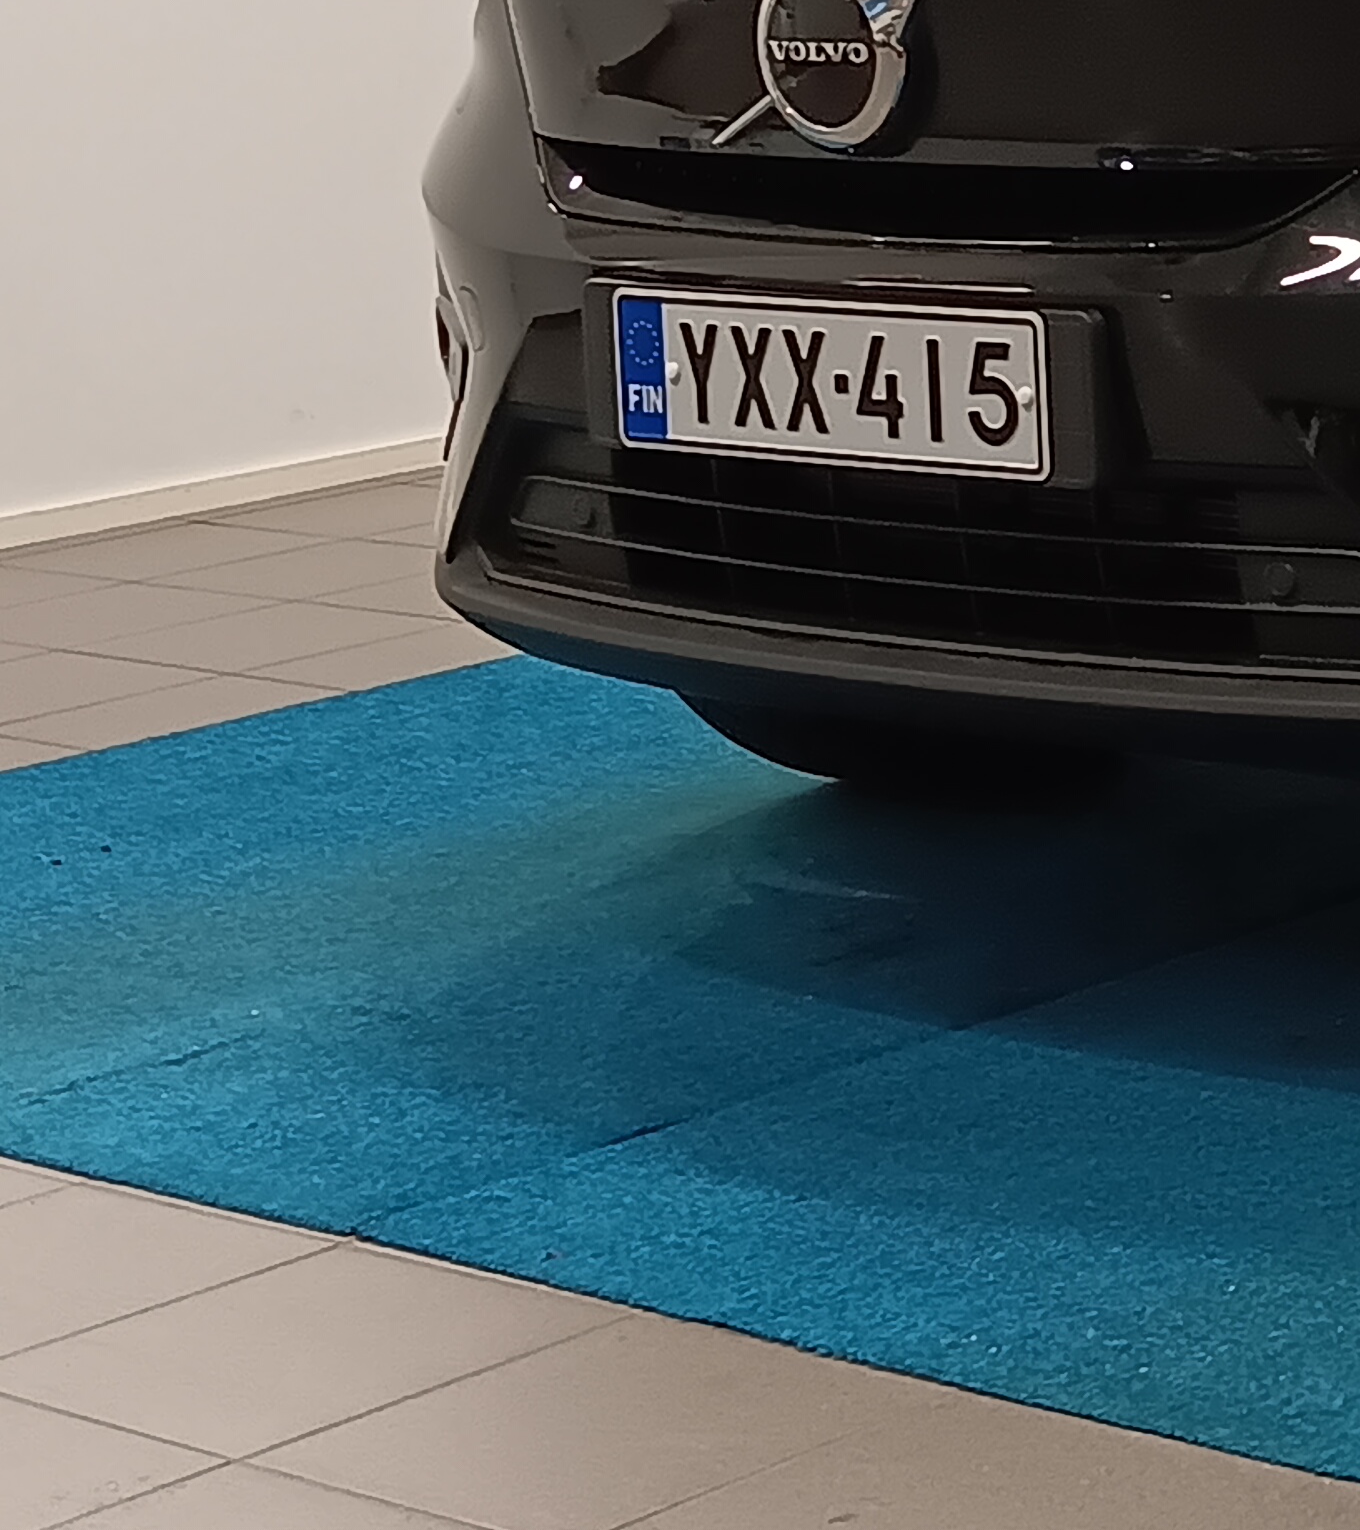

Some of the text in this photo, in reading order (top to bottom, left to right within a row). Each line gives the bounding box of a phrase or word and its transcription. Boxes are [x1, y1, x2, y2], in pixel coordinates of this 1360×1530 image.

[767, 39, 870, 64] VOLVO
[628, 382, 664, 414] FIN
[679, 321, 1020, 447] YXX-415
